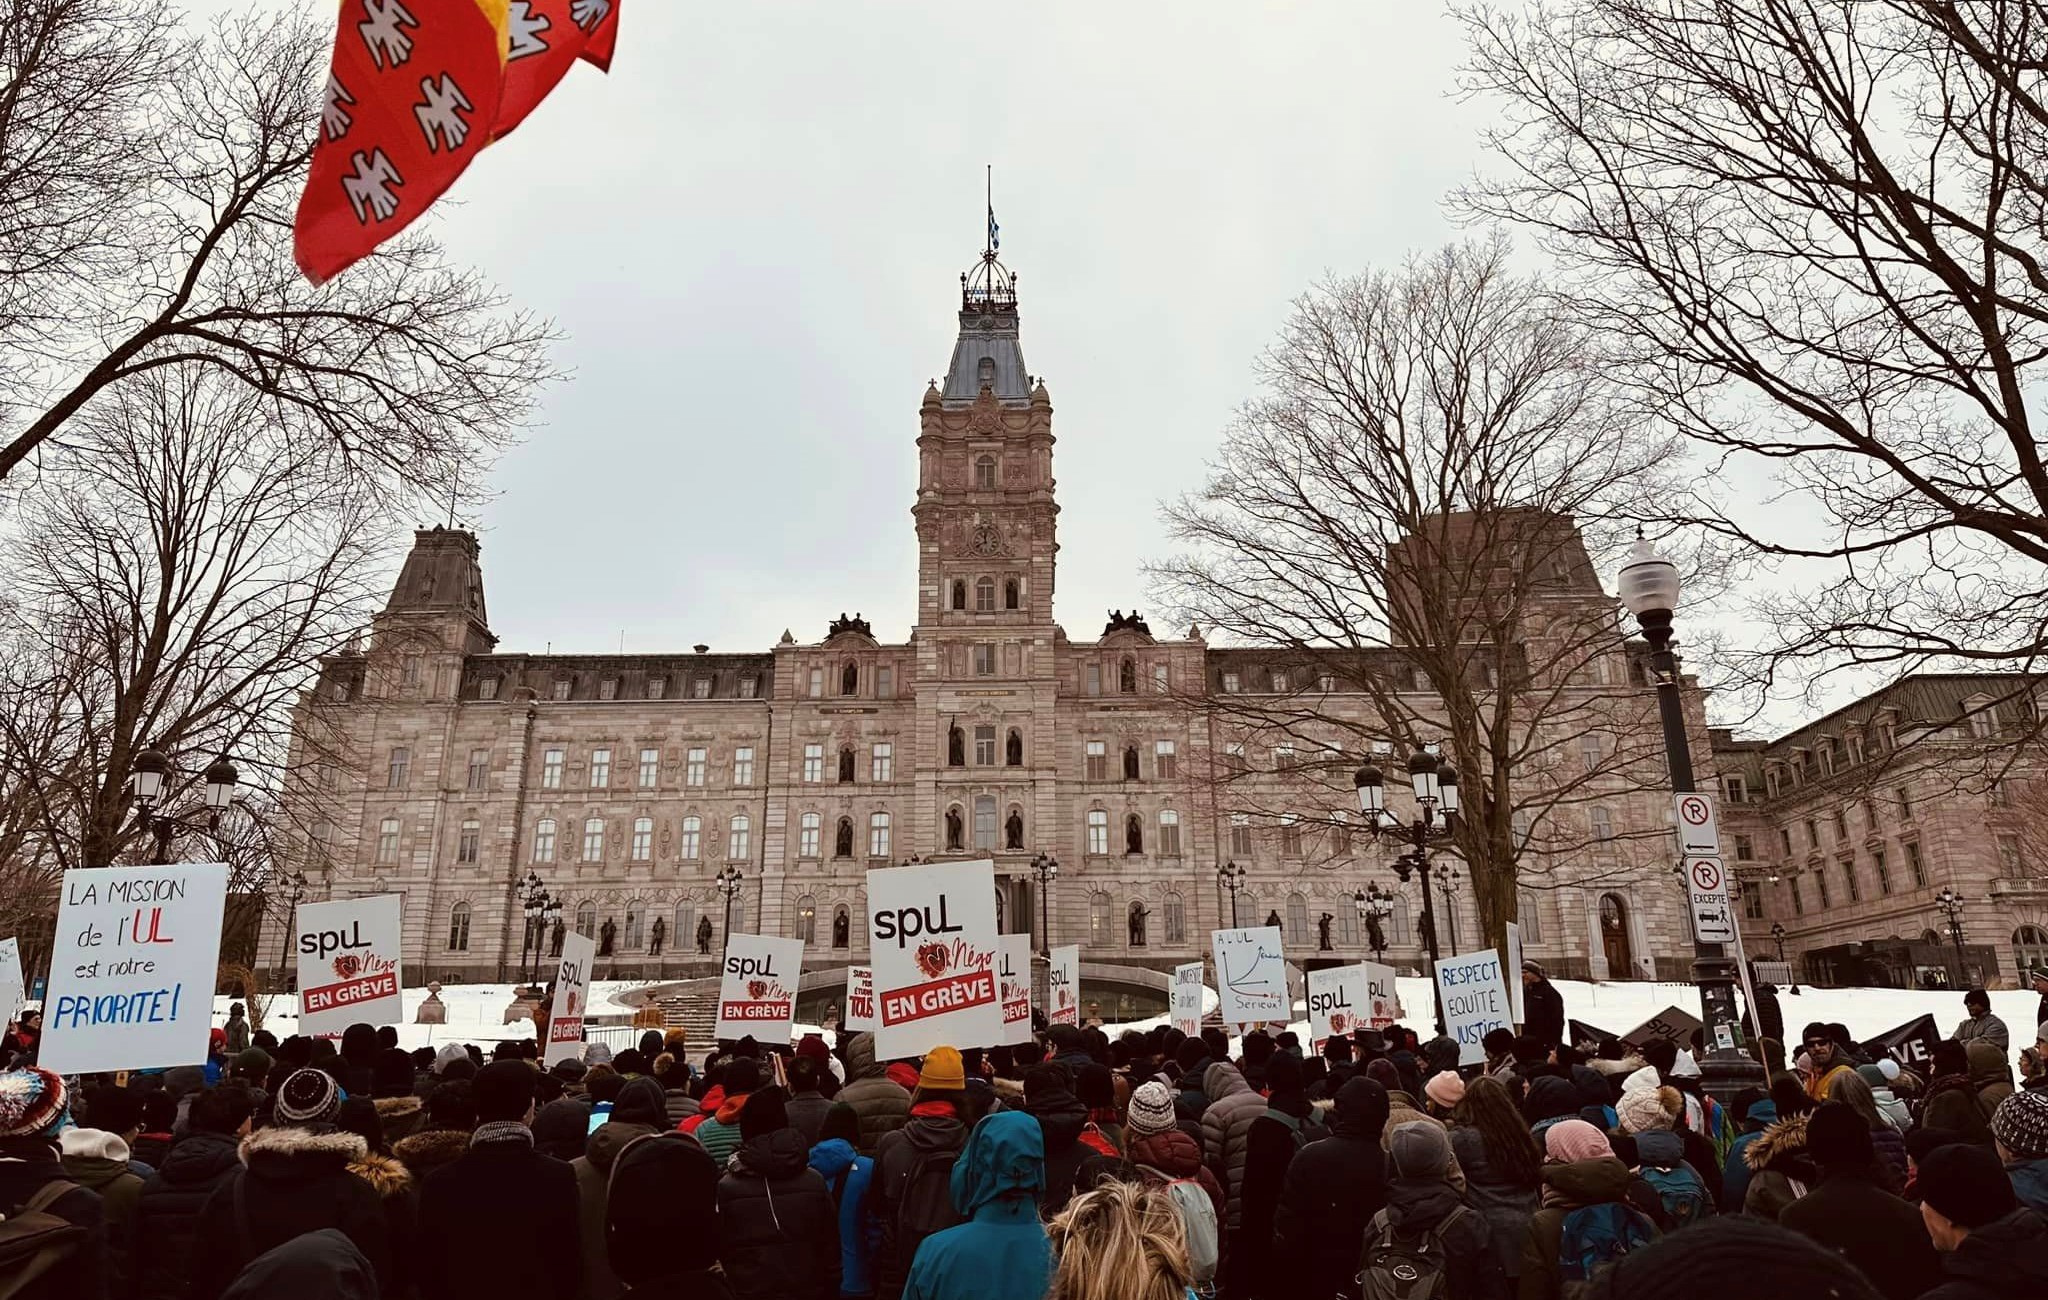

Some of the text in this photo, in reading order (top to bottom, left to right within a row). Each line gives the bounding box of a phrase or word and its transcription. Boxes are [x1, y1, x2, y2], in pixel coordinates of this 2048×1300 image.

[69, 878, 186, 905] LA MISSION
[77, 923, 102, 948] de
[74, 957, 155, 978] est notre
[951, 937, 996, 973] Négo
[1442, 961, 1498, 987] RESPECT
[53, 983, 181, 1029] PRIORITÉ!
[307, 977, 394, 1011] EN GRÈVE
[886, 977, 992, 1020] EN GRÈVE
[725, 1003, 788, 1017] EN GRÈVE
[1003, 1004, 1028, 1021] RÈVE
[1889, 1038, 1929, 1064] VE
